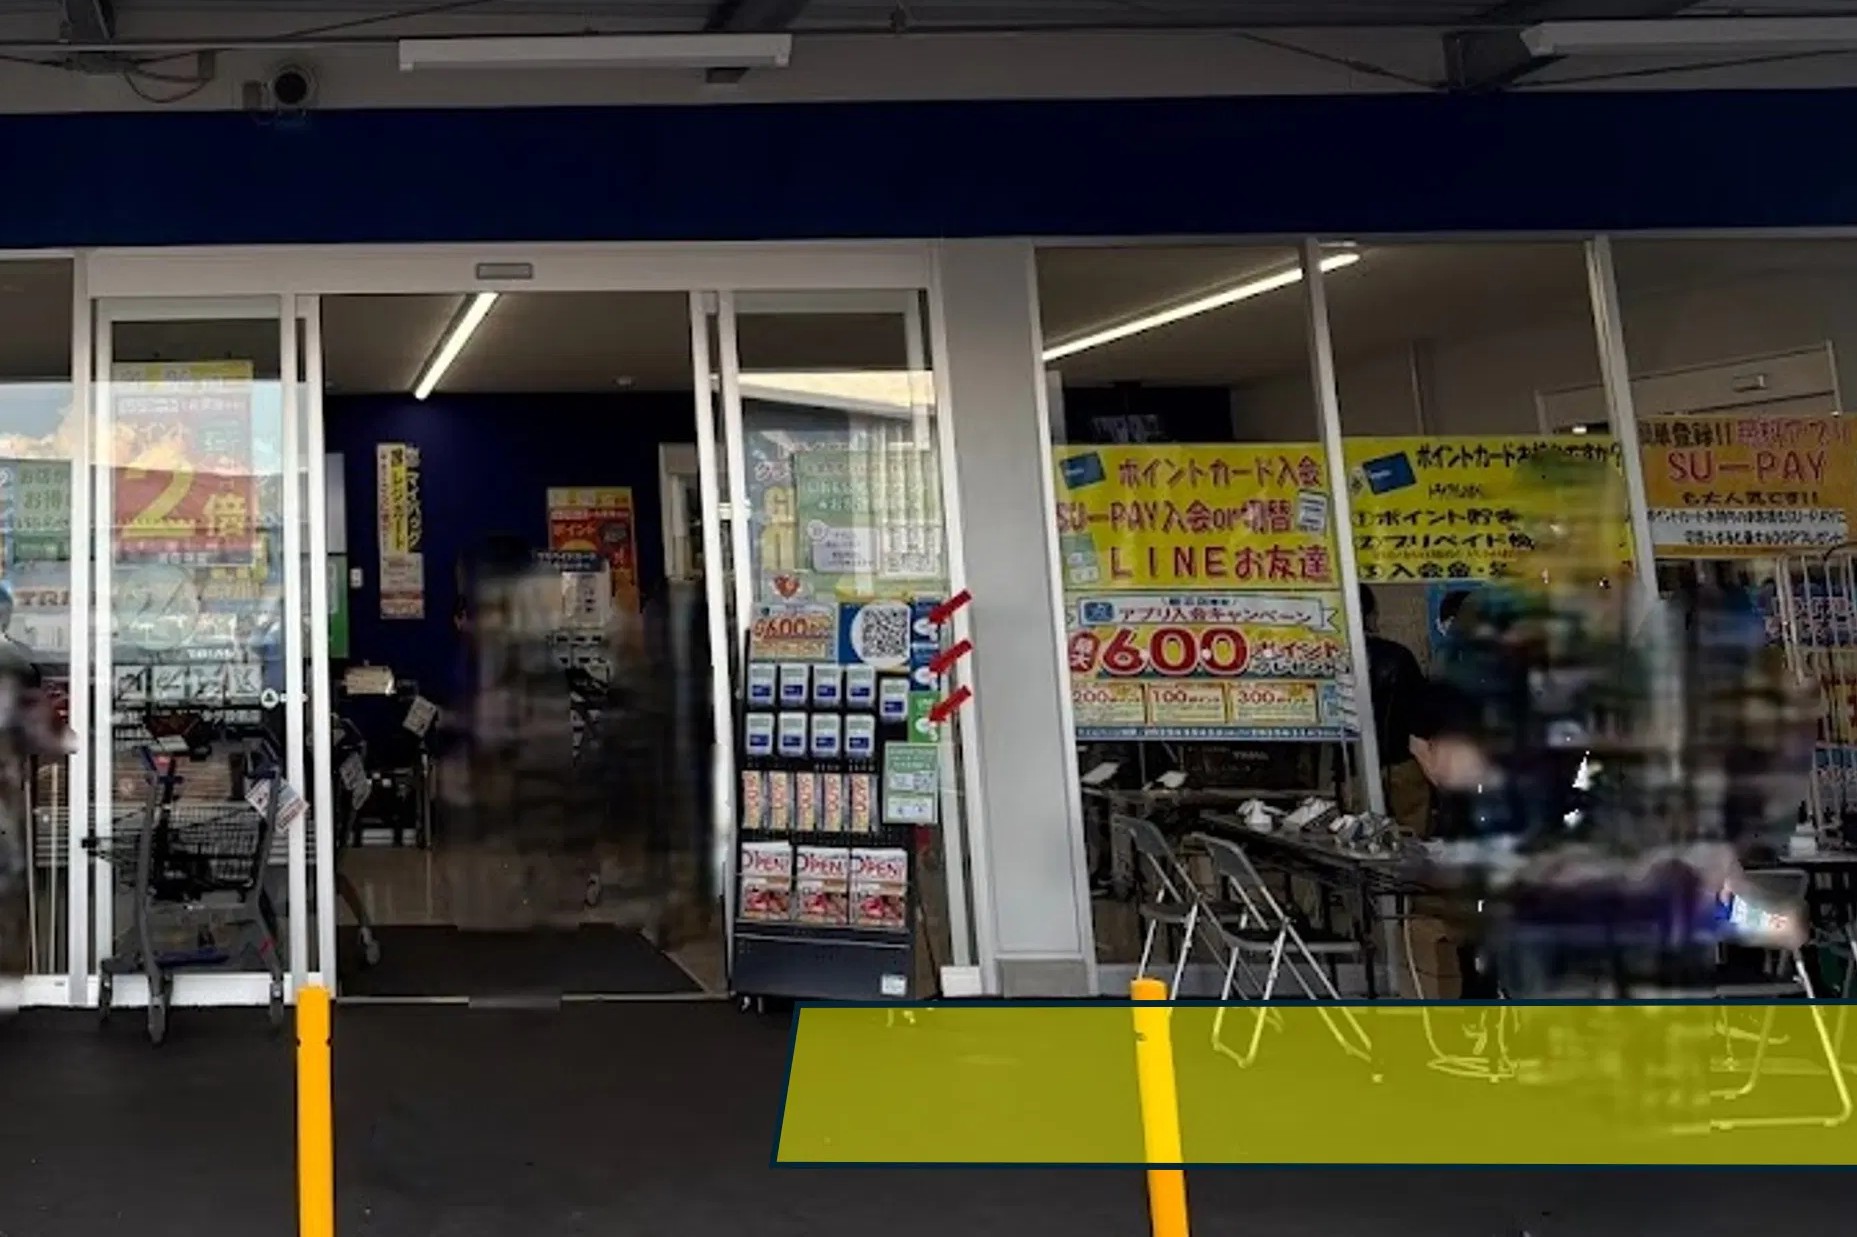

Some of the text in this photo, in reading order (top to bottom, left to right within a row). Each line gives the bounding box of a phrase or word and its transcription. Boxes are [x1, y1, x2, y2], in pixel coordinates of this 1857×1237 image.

[1119, 454, 1321, 488] ポイントカード入会
[1110, 544, 1331, 582] LINEお友達
[1103, 627, 1249, 676] 600
